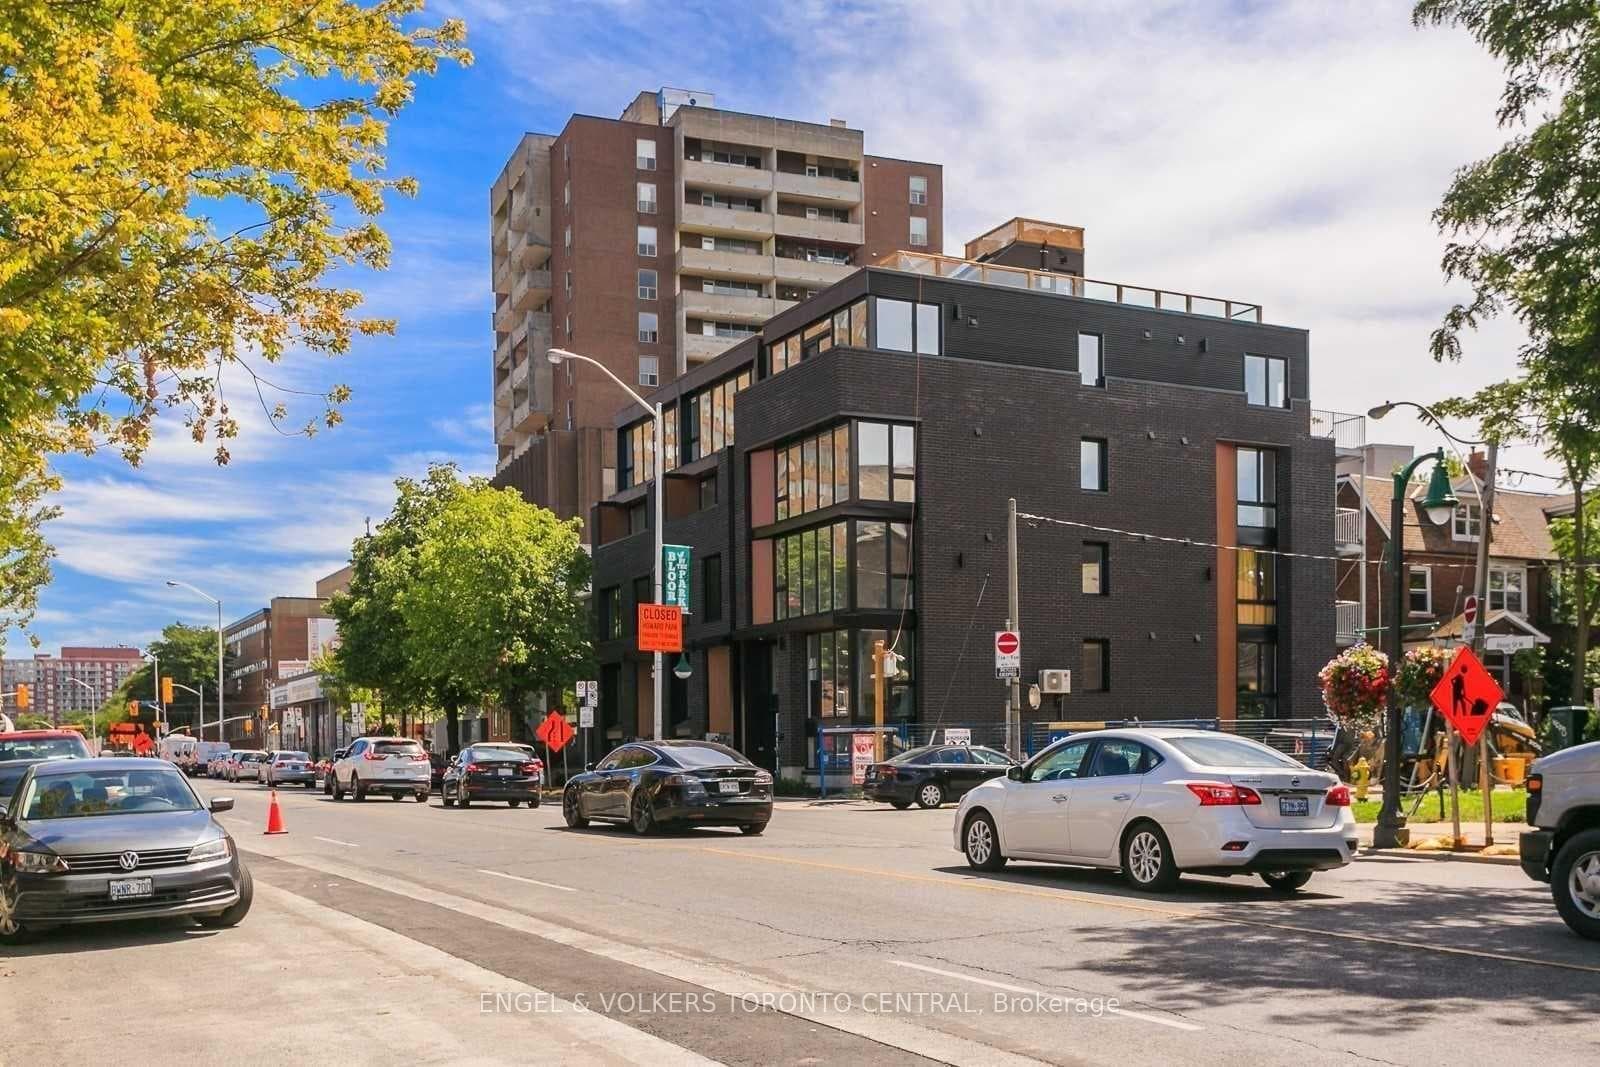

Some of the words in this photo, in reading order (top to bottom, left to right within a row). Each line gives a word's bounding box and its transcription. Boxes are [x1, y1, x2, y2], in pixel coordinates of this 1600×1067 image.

[667, 551, 676, 601] BLOOR
[677, 570, 687, 607] PARK
[643, 608, 678, 621] CLOSED
